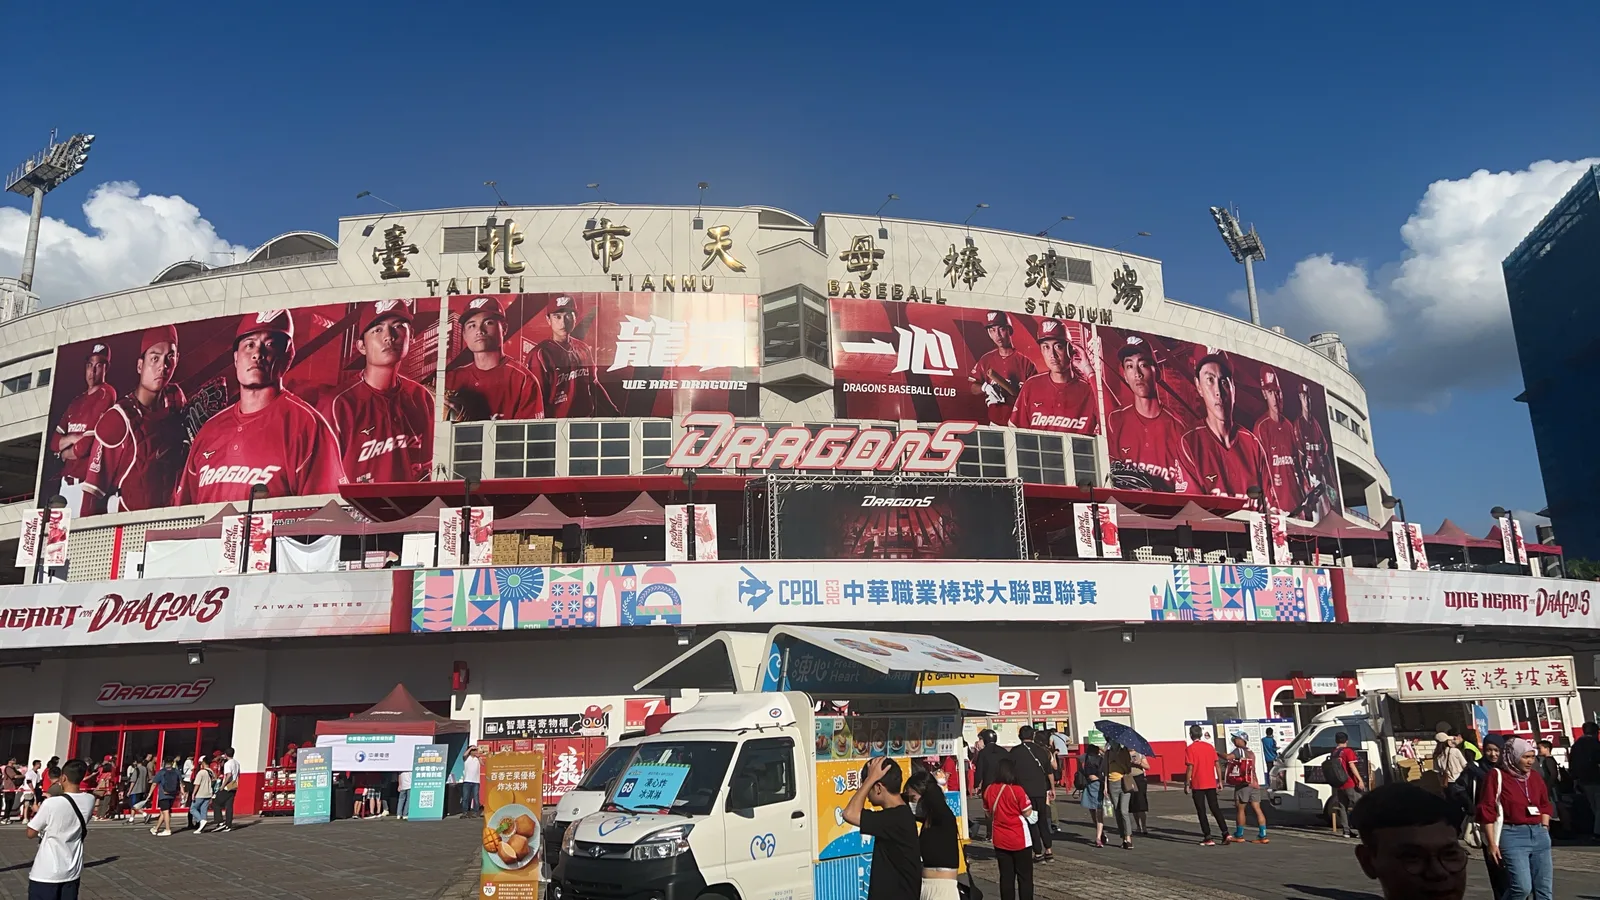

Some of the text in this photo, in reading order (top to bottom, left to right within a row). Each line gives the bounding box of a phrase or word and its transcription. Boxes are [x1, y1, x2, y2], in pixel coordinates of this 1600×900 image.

[426, 274, 1113, 325] TAIPEI TIANMU BASEBALL STADIUM
[606, 315, 747, 372] 龍
[841, 324, 959, 376] 一心
[622, 380, 747, 390] WE ARE DRAGONS
[843, 383, 956, 397] DRAGONS BASEBALL CLUB
[1031, 412, 1088, 429] DRAGONS
[666, 411, 978, 472] DRAGONS
[199, 465, 281, 487] DRAGONS
[861, 495, 936, 507] DRAGONS
[779, 579, 1098, 606] CPBL 2023 中華職業棒球大聯盟聯賽
[87, 587, 229, 634] DRAGONS
[1443, 590, 1479, 611] ONE
[1481, 592, 1530, 613] HEART
[1536, 588, 1591, 619] DRAGONS
[830, 671, 860, 683] Heart
[1461, 664, 1570, 690] 窯烤披薩
[97, 678, 213, 702] DRAGONS
[999, 691, 1020, 710] 8
[1039, 691, 1061, 710] 9
[1098, 689, 1127, 707] 10
[643, 700, 661, 720] 7
[621, 782, 635, 793] 68
